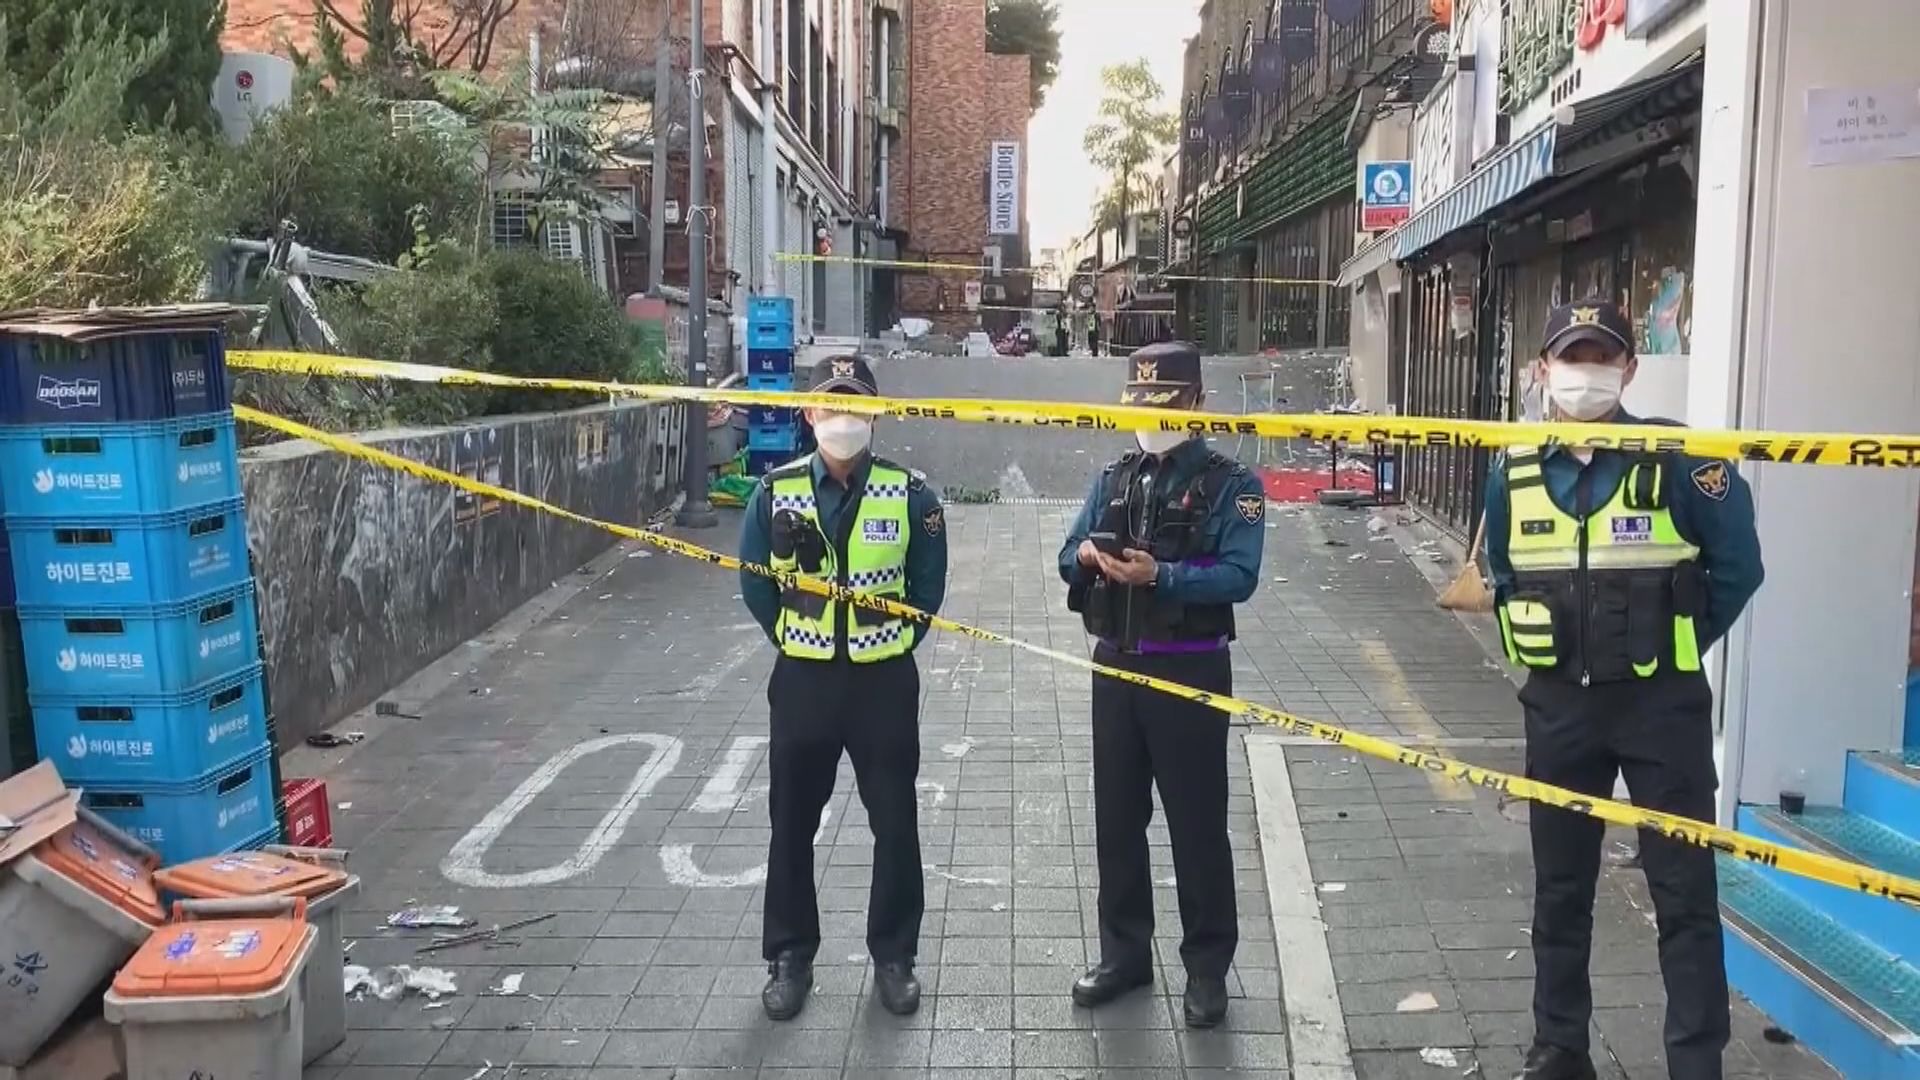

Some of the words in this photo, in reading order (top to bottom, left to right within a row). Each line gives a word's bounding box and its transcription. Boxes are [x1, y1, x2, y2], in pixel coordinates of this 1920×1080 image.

[236, 91, 252, 102] LG
[997, 145, 1015, 190] Bottle
[996, 192, 1014, 229] Store
[172, 370, 205, 387] (주)두산
[39, 385, 98, 399] DOOSAN
[57, 473, 122, 489] 하이트진로
[865, 534, 897, 542] POLICE
[1614, 534, 1650, 542] POLICE
[46, 562, 133, 583] 하이트진로
[79, 652, 144, 669] 하이트진로
[89, 739, 154, 756] 하이트진로
